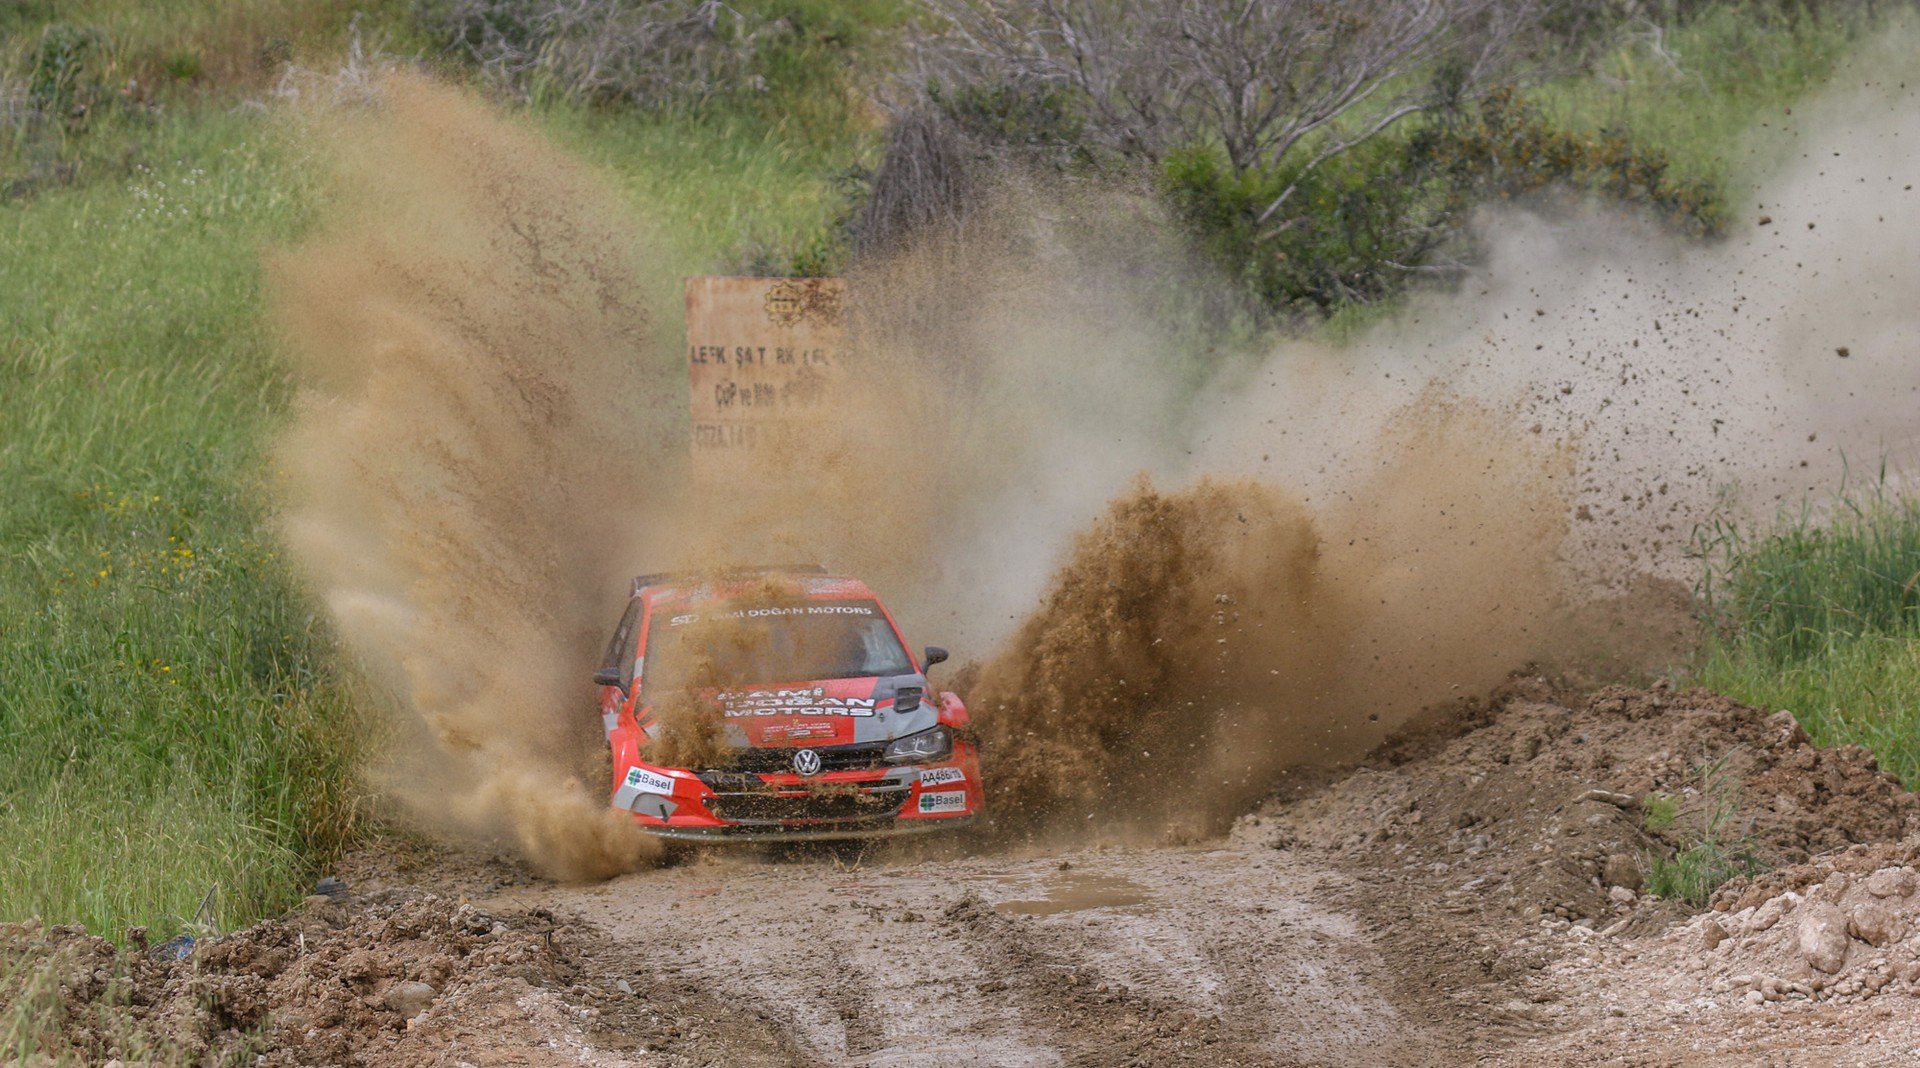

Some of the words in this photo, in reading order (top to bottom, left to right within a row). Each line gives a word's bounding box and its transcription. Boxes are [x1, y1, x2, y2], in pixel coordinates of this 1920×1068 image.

[807, 605, 873, 616] MOTORS
[724, 707, 877, 718] MOTORS
[641, 774, 671, 790] Basel
[935, 793, 963, 805] Basel
